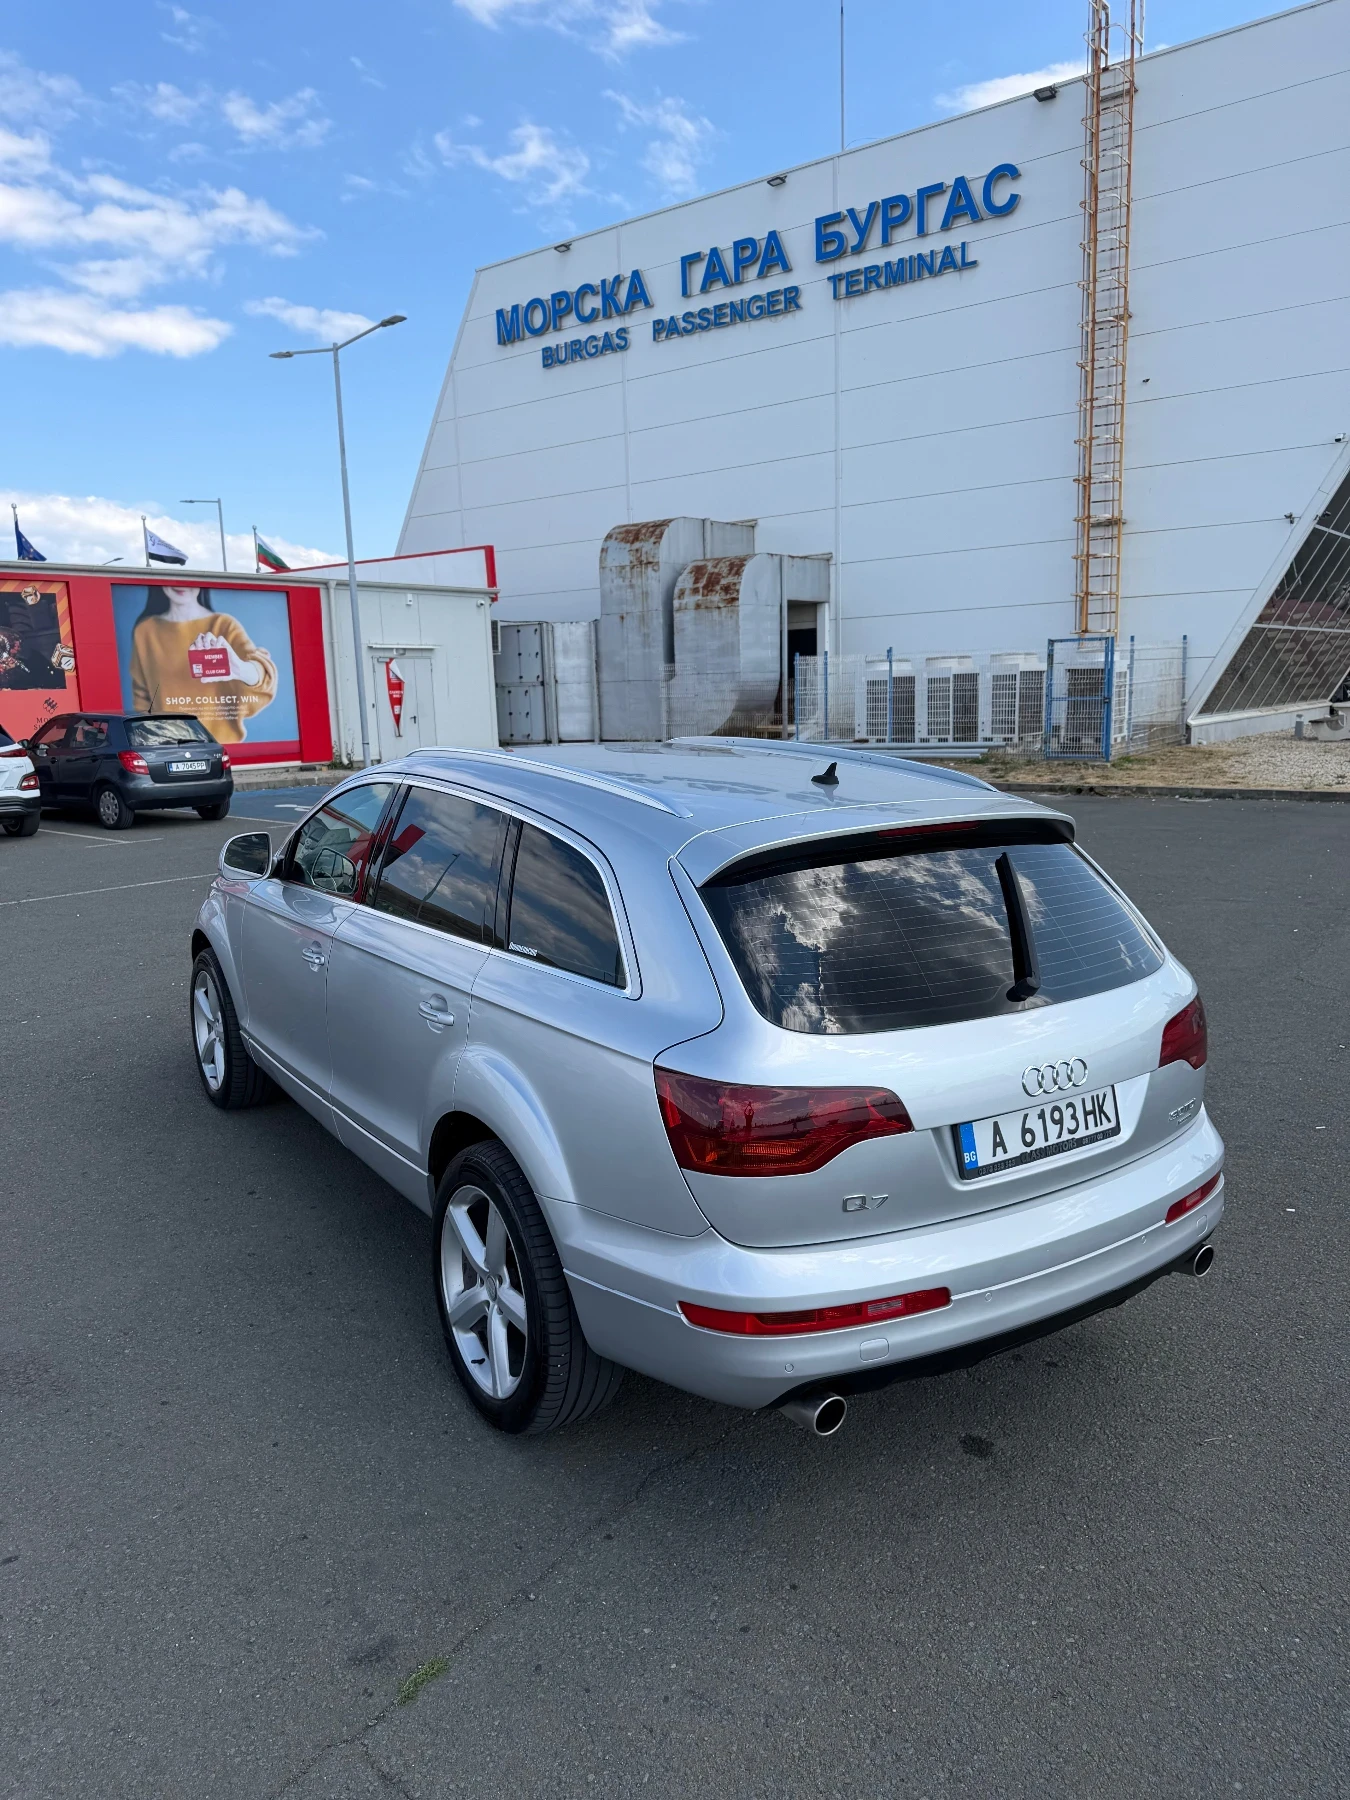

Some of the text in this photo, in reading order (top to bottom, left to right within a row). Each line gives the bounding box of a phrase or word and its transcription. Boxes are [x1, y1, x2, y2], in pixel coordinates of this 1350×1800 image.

[495, 163, 1021, 346] МОРСКА ГАРА БУРГАС
[541, 241, 979, 368] BURGAS PASSENGER TERMINAL
[166, 695, 259, 705] SHOP. COLLECT. WIN
[992, 1120, 1008, 1158] A
[1045, 1138, 1077, 1157] MOTORS
[963, 1151, 977, 1164] BG
